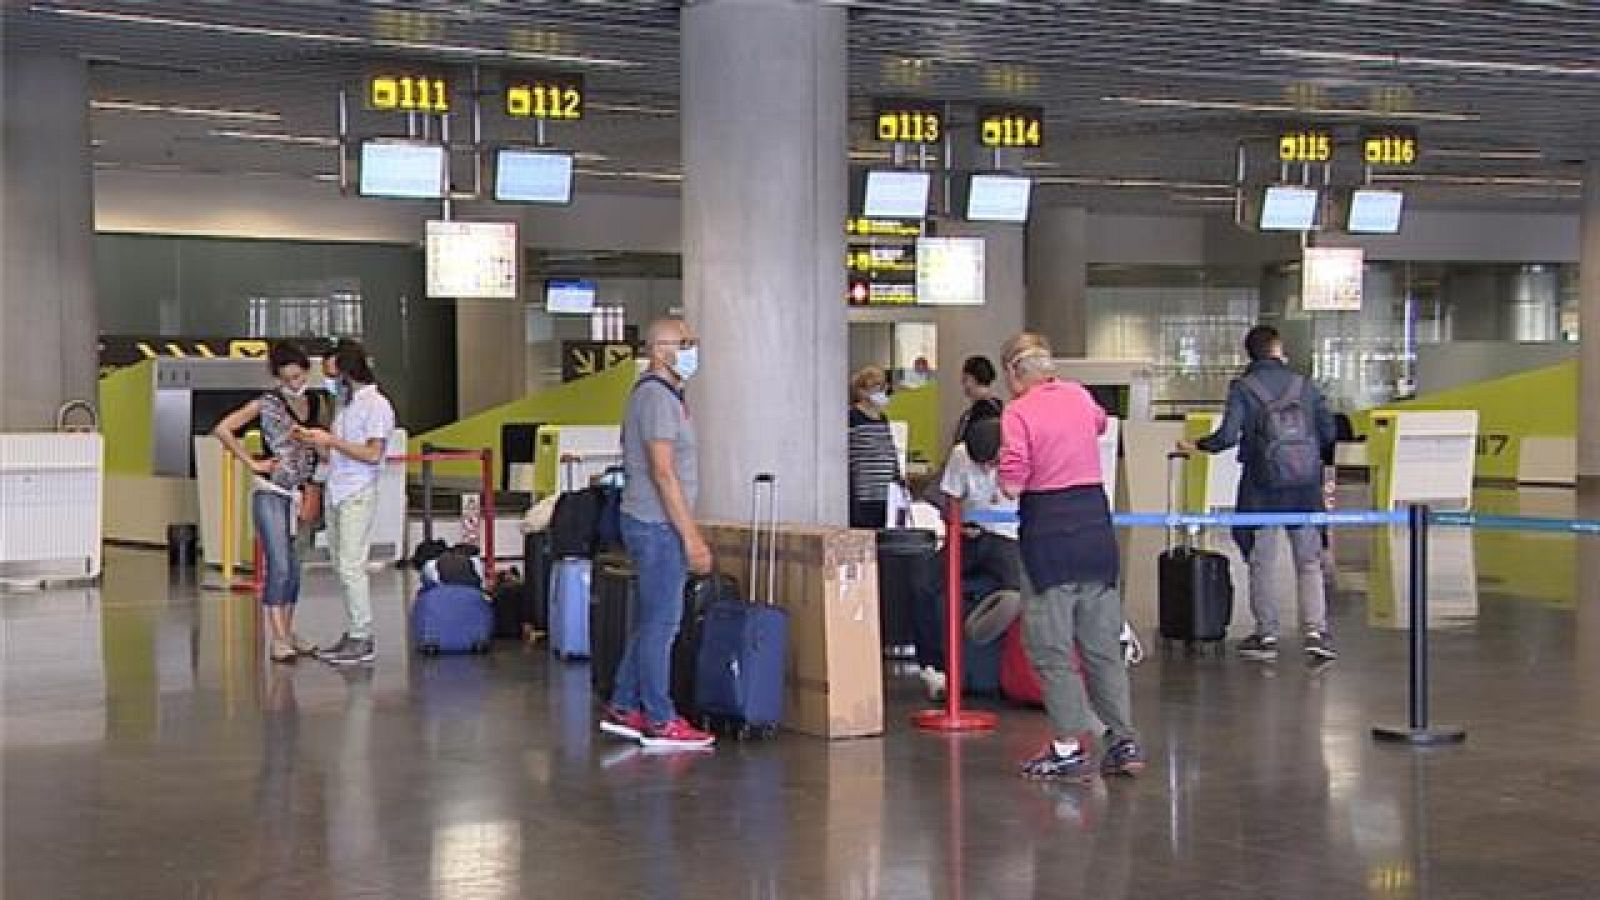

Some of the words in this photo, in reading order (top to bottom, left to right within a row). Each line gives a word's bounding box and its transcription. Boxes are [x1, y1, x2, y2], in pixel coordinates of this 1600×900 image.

[400, 77, 448, 110] 111
[533, 86, 581, 118] 112
[900, 112, 939, 142] 113
[1003, 116, 1041, 145] 114
[1299, 134, 1330, 161] 115
[1384, 137, 1416, 162] 116
